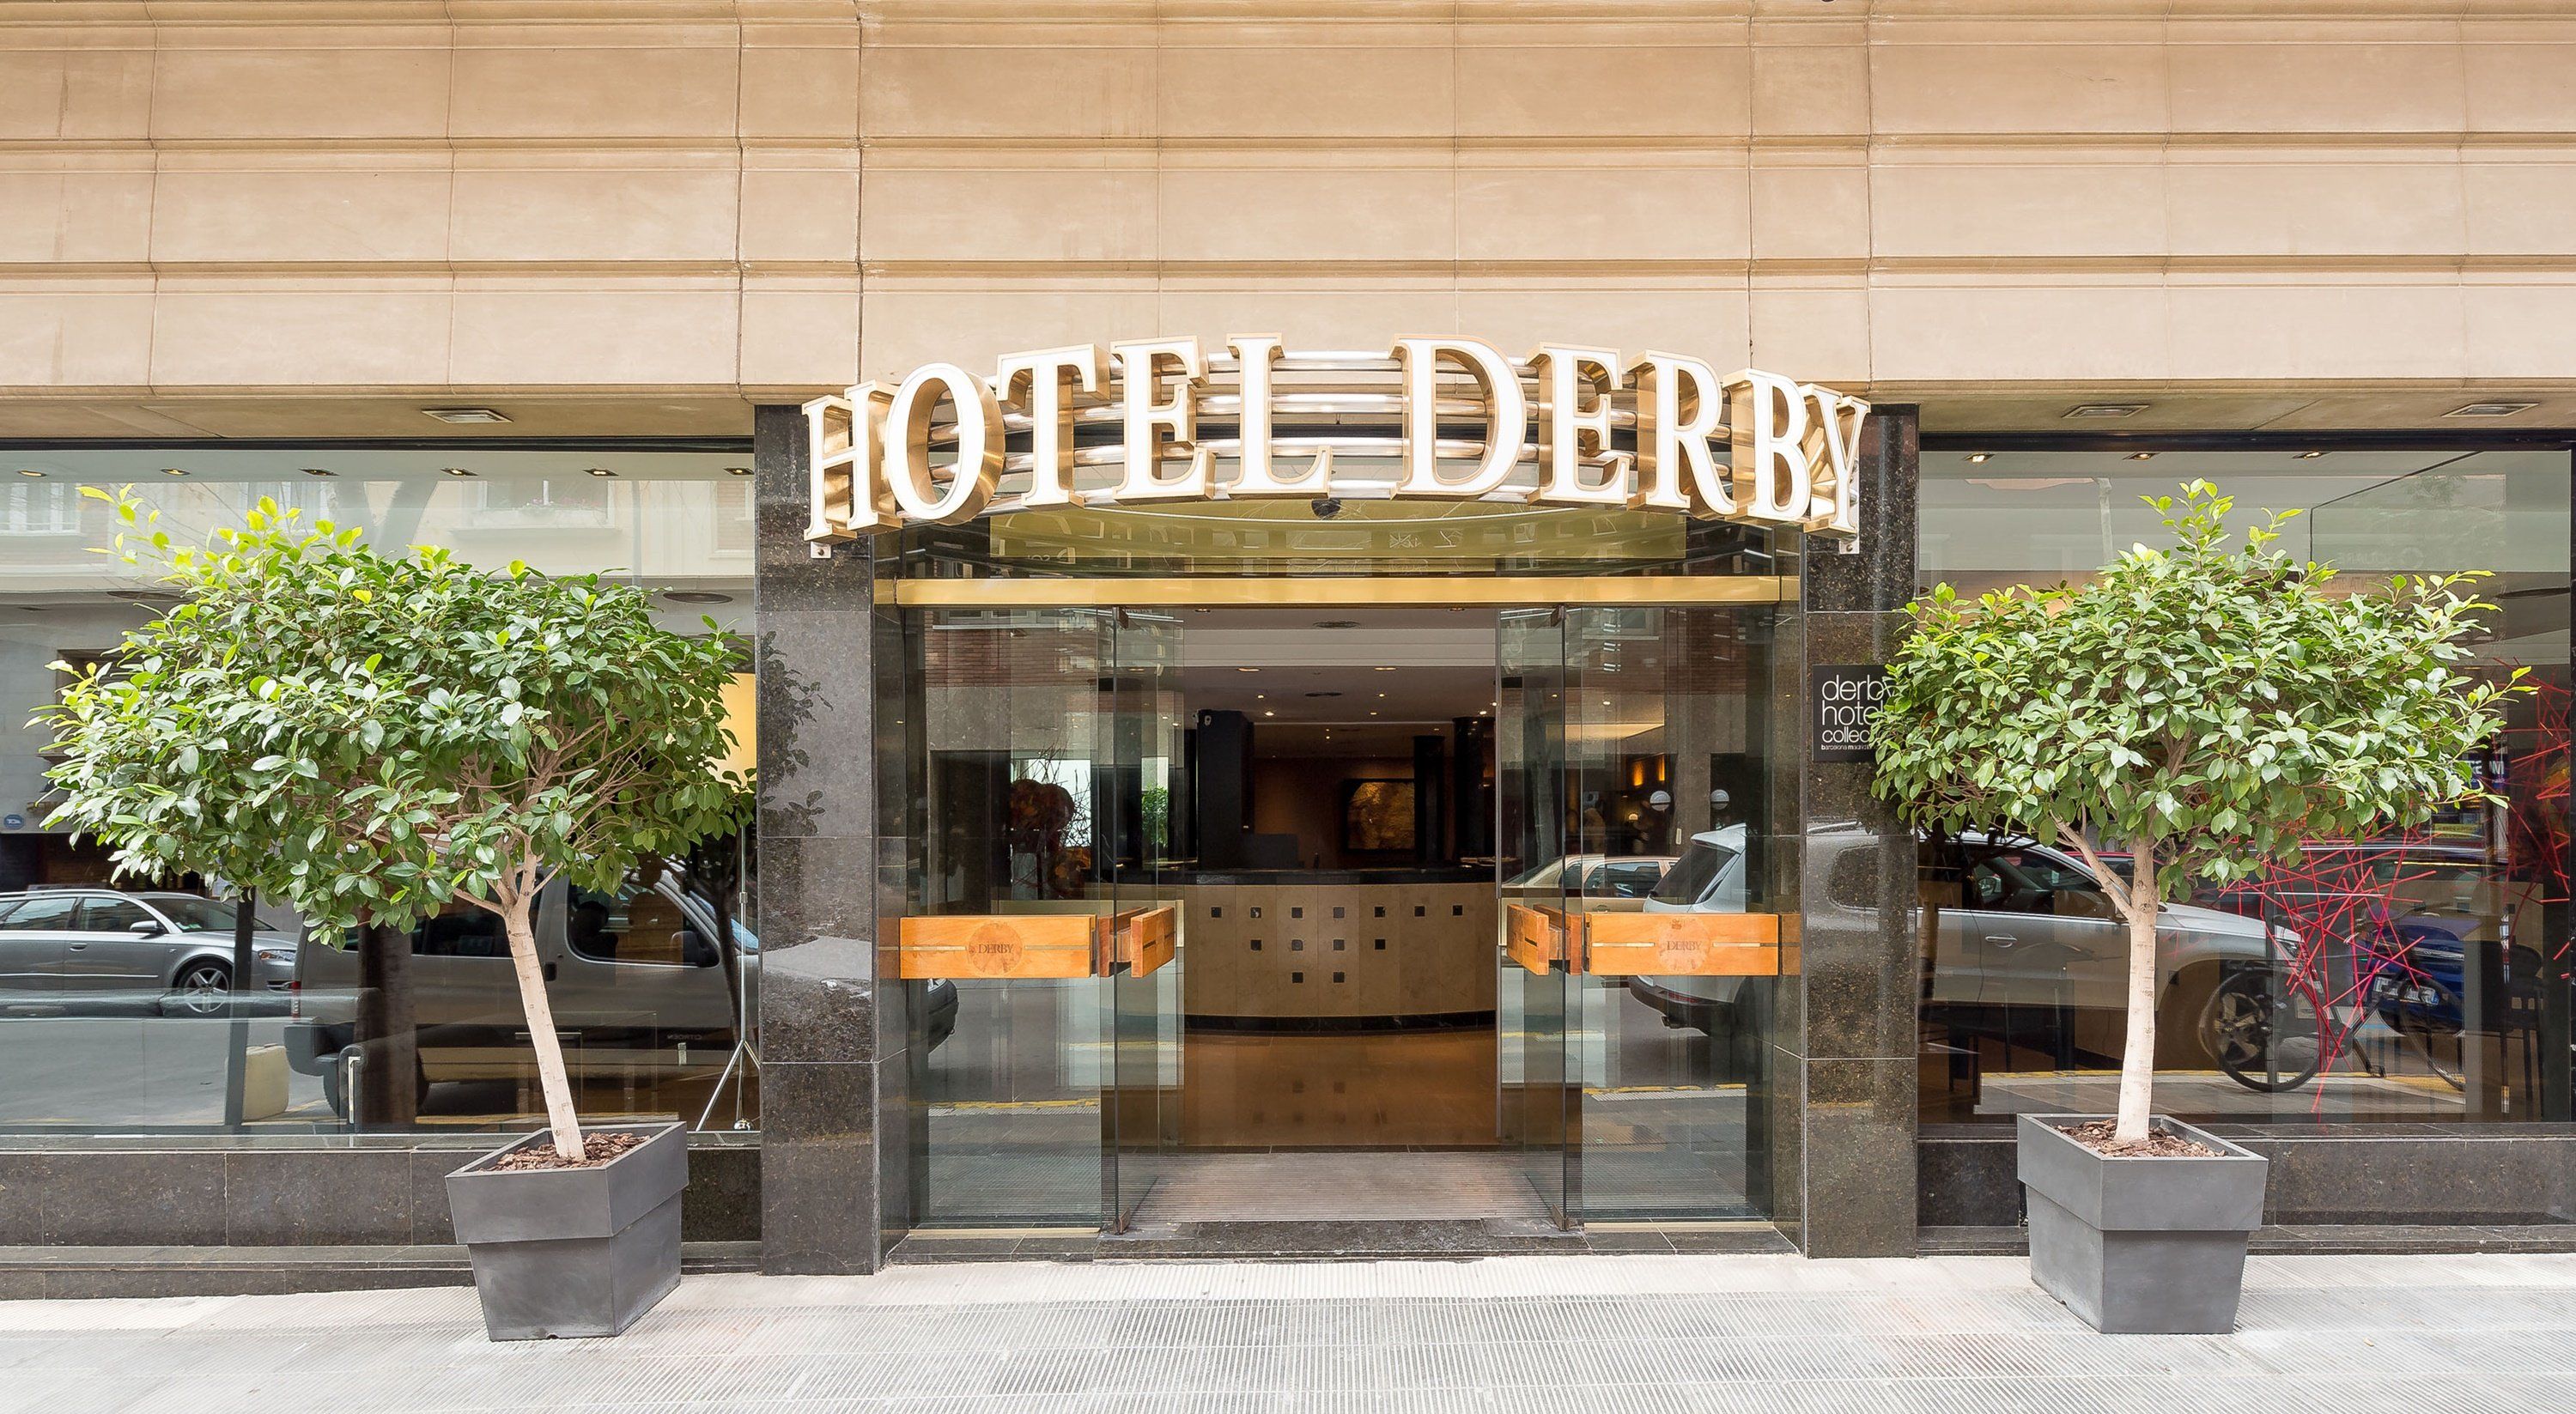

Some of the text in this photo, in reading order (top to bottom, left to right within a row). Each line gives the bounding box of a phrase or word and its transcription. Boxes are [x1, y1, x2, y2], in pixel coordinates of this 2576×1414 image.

[802, 332, 1871, 543] HOTEL DERBY
[1822, 726, 1869, 743] collec
[978, 944, 1014, 954] DERBY
[1666, 940, 1701, 950] DERBY
